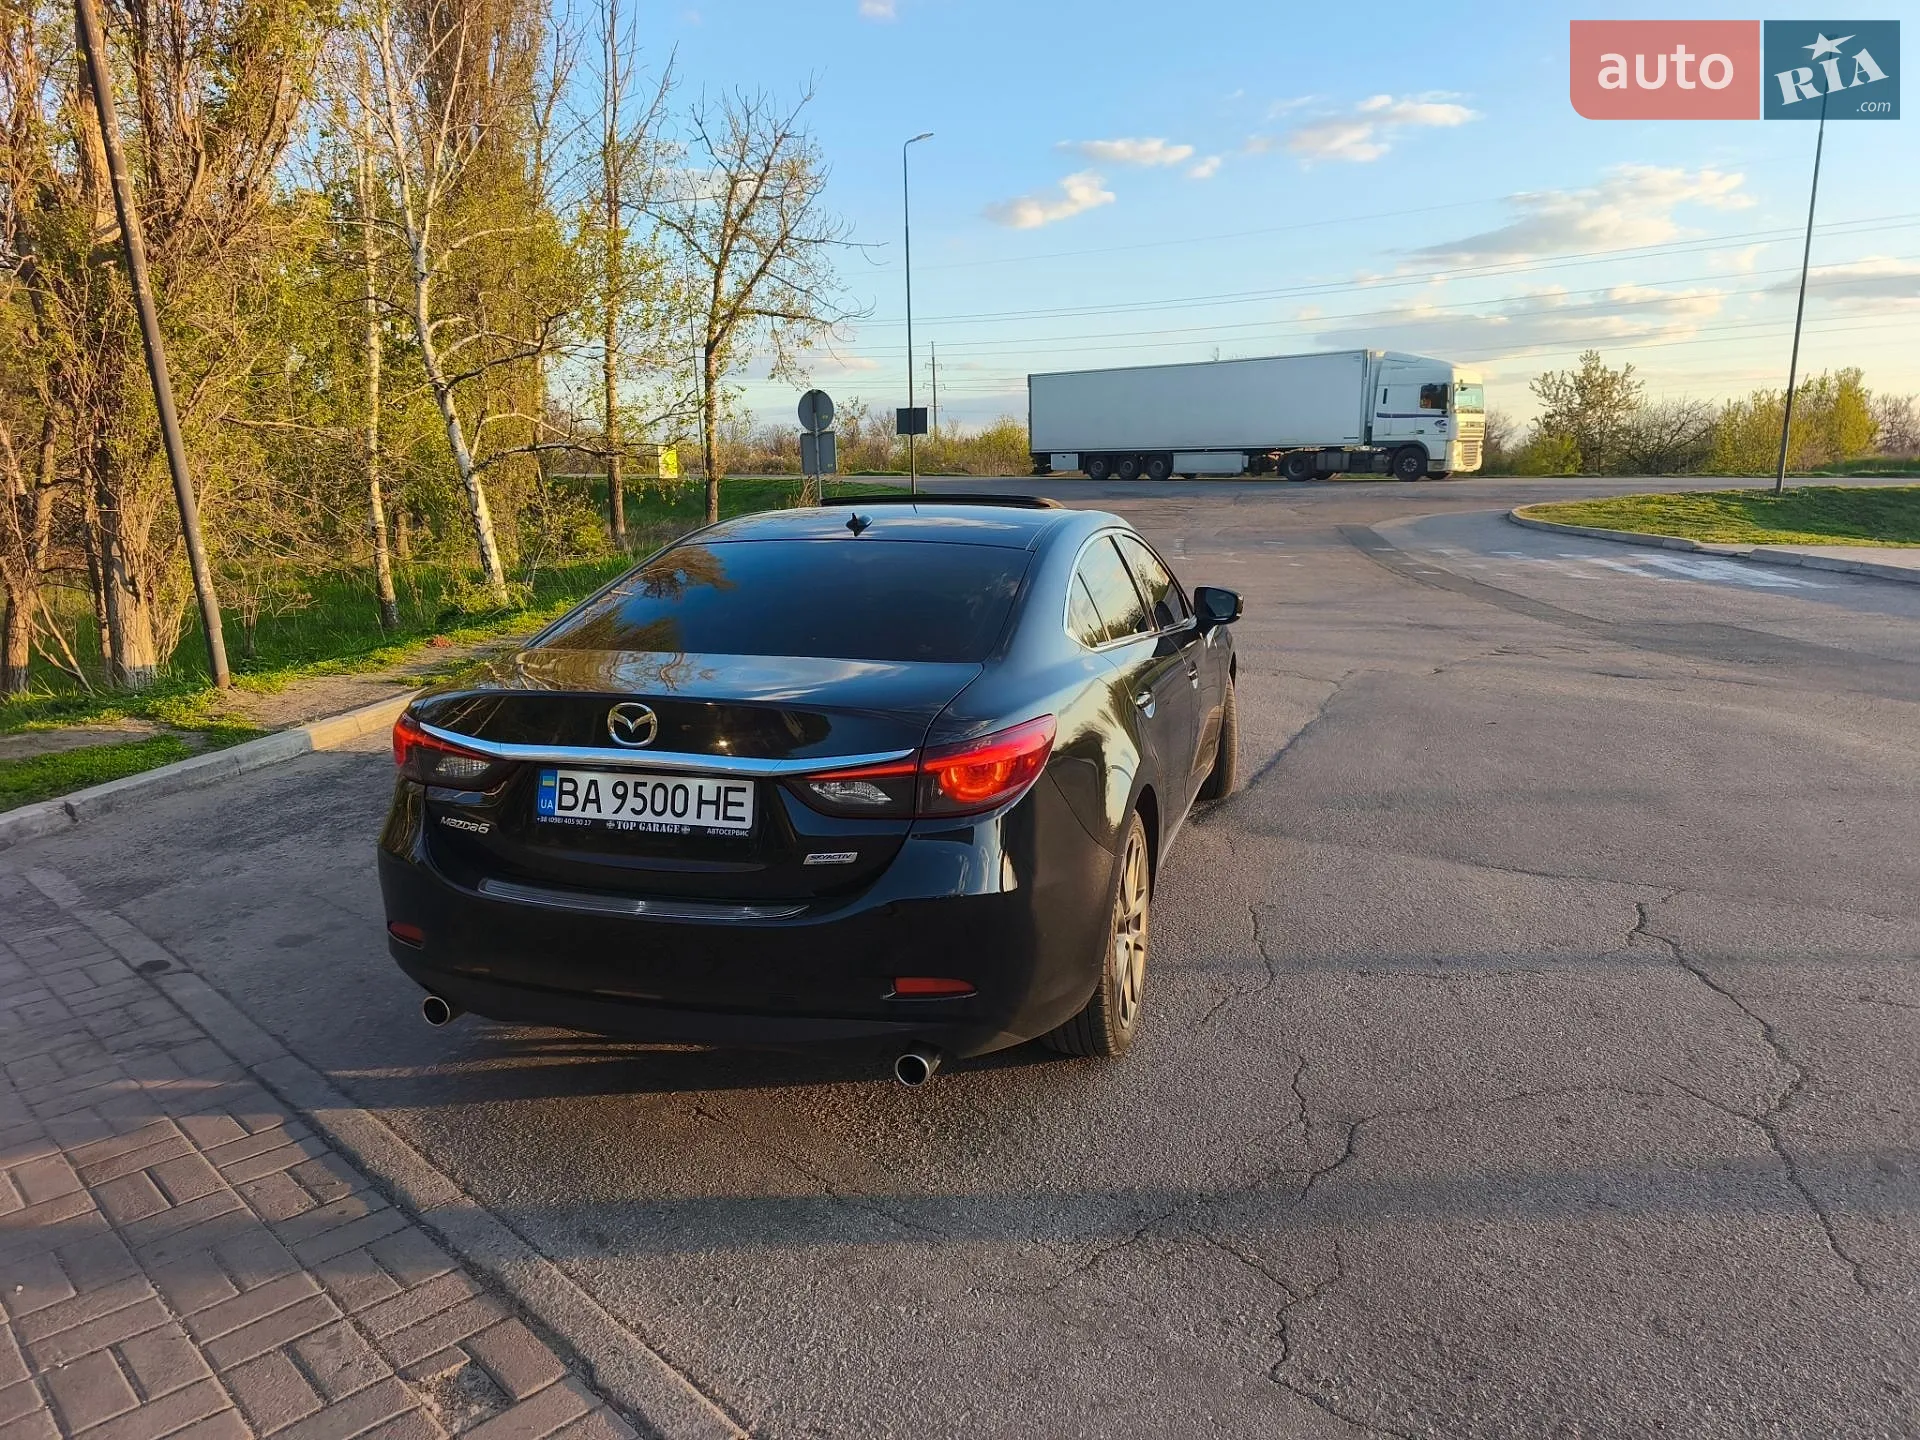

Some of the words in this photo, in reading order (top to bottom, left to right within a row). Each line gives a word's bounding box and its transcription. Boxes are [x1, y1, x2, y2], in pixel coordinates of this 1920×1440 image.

[541, 799, 553, 810] UA
[557, 777, 602, 813] BA
[612, 780, 689, 817] 9500
[696, 785, 746, 821] HE
[616, 821, 636, 831] TOP
[639, 822, 680, 834] GARAGE
[707, 827, 749, 836] АВТОСЕРВИС
